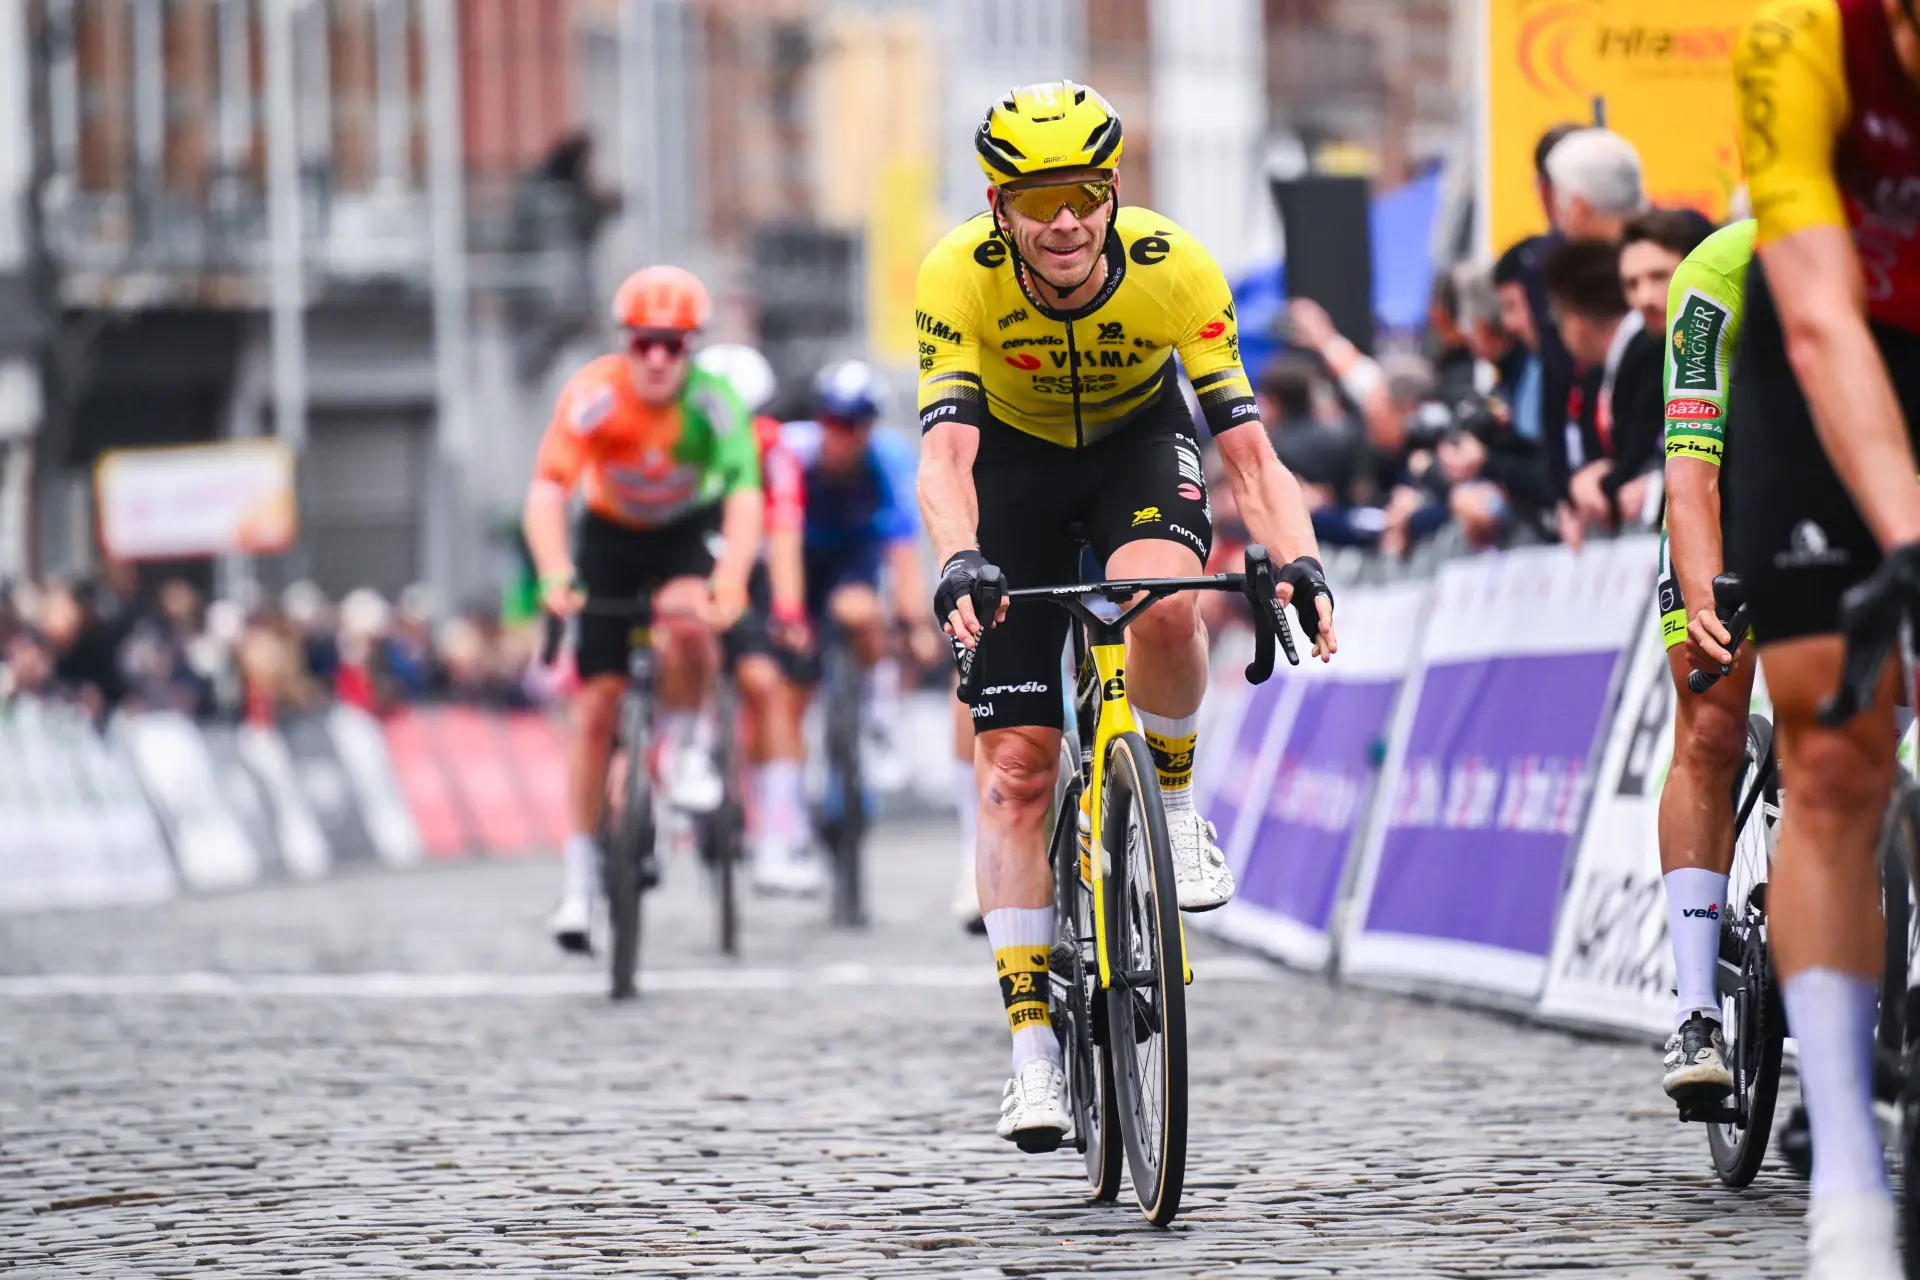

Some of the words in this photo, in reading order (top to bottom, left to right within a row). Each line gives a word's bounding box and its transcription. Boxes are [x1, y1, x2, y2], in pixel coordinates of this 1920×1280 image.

[915, 308, 963, 345] VISMA
[998, 307, 1029, 331] nimbl
[1685, 305, 1716, 384] WAGNER
[1667, 403, 1717, 416] Bazin
[1169, 523, 1207, 557] nimbl
[1011, 1007, 1044, 1026] DEFEET
